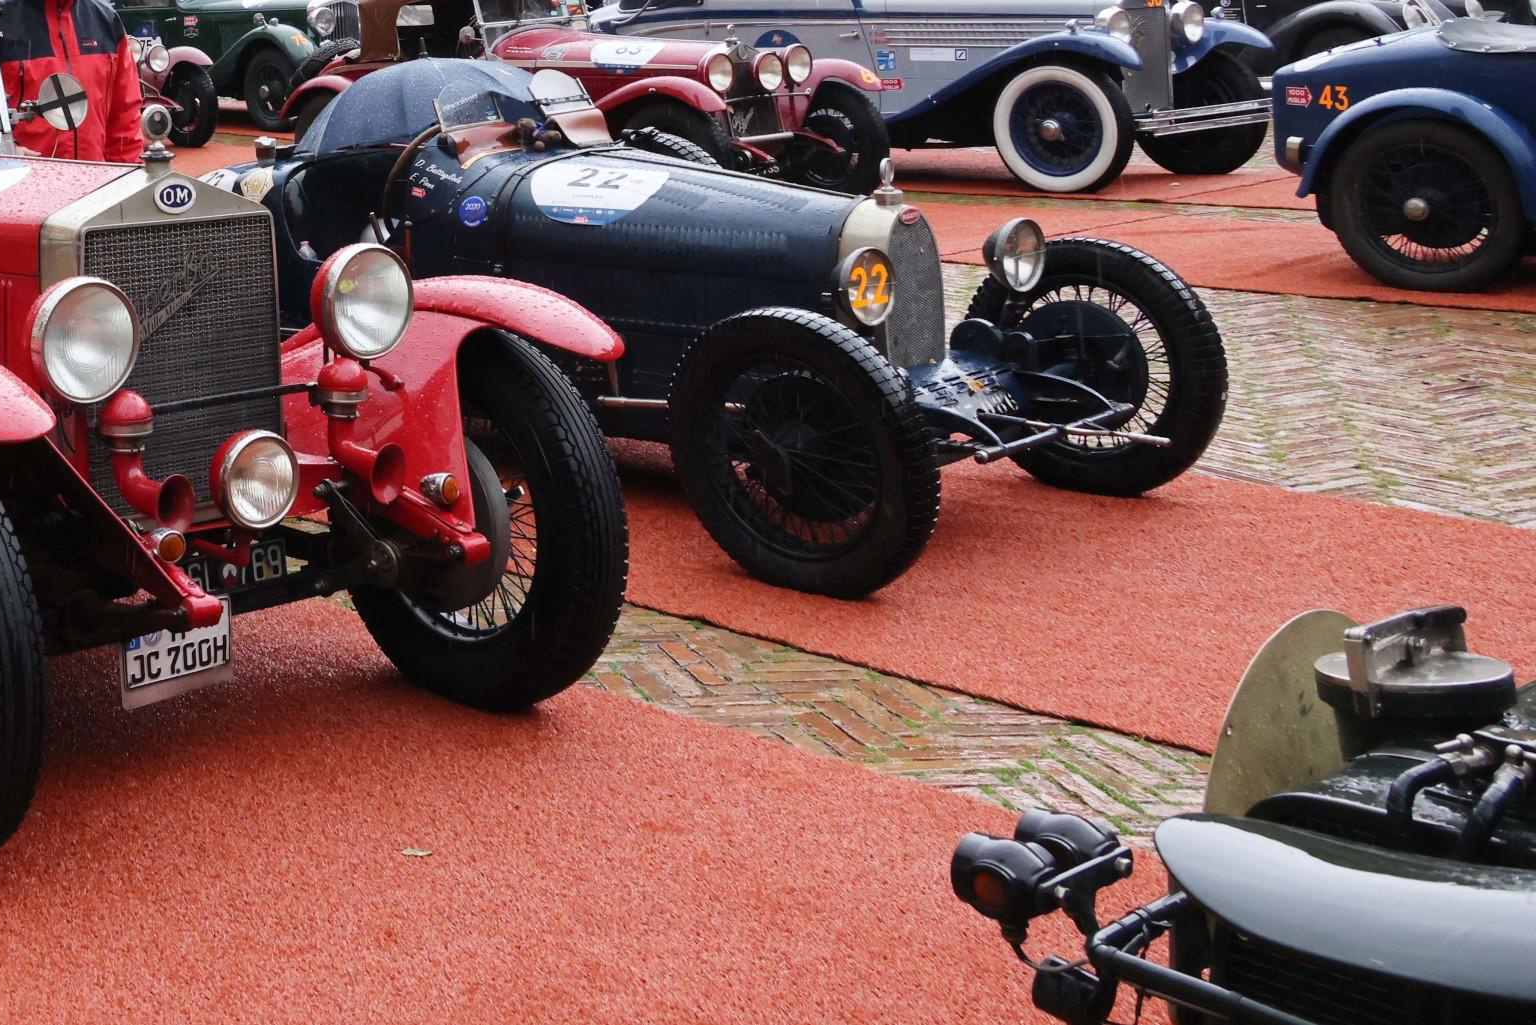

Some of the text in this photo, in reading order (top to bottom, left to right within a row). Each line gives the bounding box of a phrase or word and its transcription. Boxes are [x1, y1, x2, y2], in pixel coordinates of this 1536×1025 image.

[290, 33, 309, 47] 75
[1287, 96, 1307, 104] MIGLIA
[1319, 85, 1349, 111] 43
[567, 167, 629, 190] 22
[163, 186, 189, 205] OM
[850, 263, 889, 309] 22
[167, 634, 228, 675] 700H
